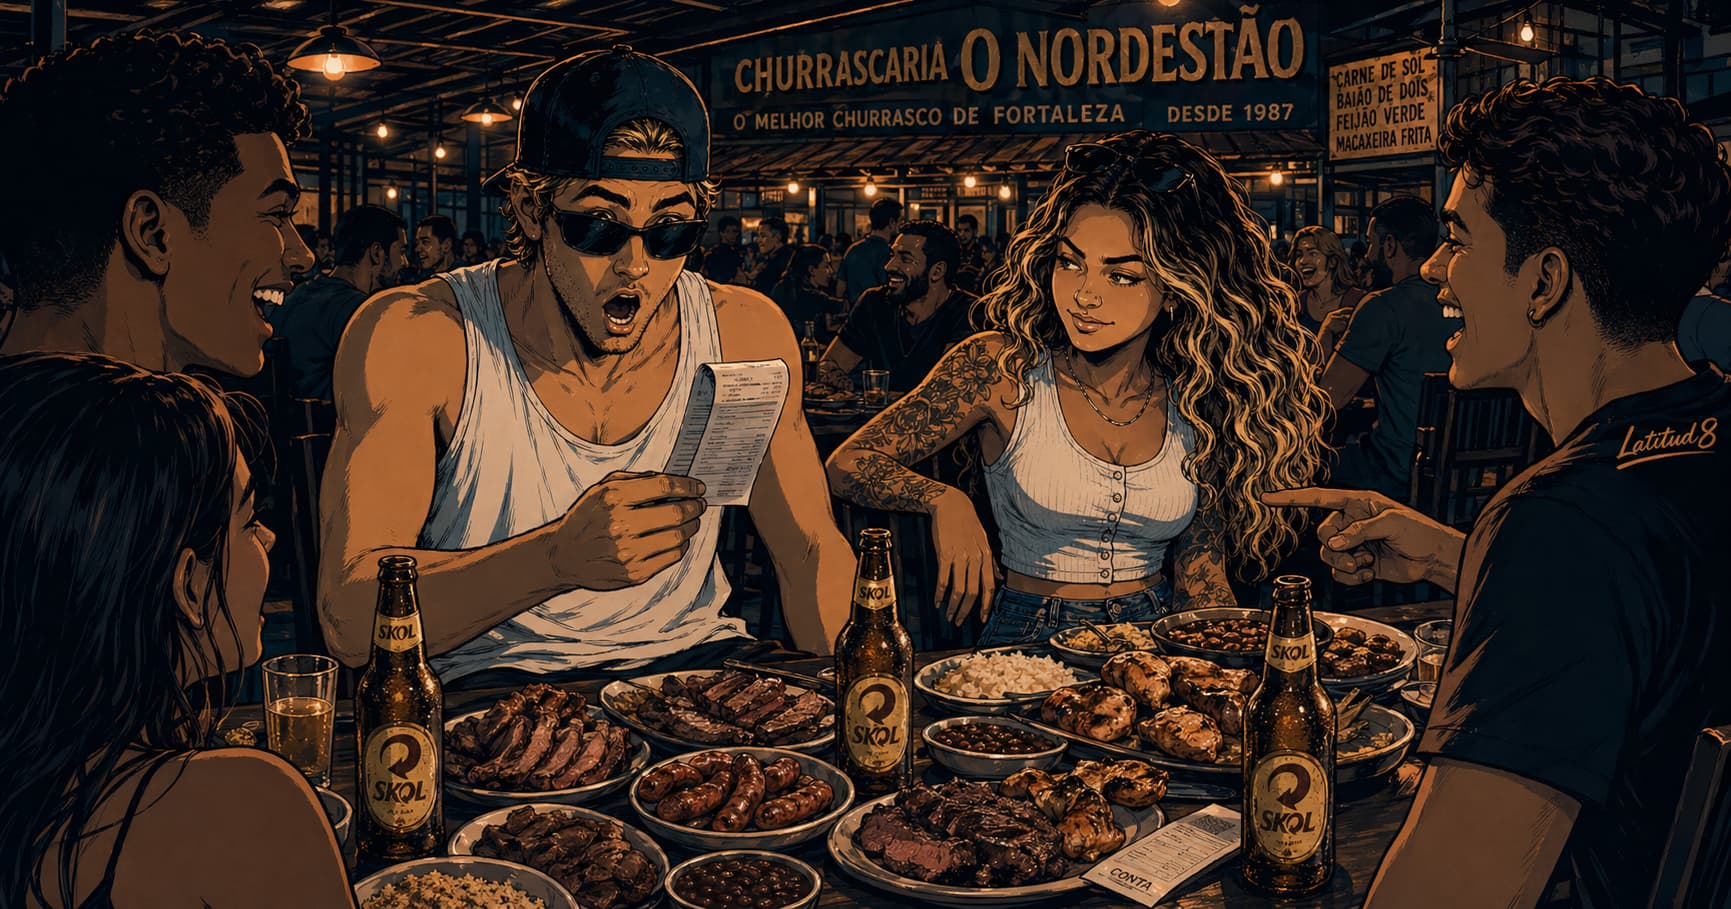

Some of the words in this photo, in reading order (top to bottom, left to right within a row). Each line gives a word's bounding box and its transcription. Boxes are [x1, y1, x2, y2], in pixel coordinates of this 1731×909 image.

[735, 41, 949, 93] CHURRASCARIA
[961, 28, 1000, 91] O
[1016, 5, 1304, 88] NORDESTÃO
[1336, 66, 1375, 88] CARNE
[1381, 61, 1396, 80] DE
[1402, 56, 1425, 76] SOL
[1337, 86, 1372, 110] BAIÃO
[1378, 84, 1393, 103] DE
[1400, 79, 1428, 100] DOIS
[733, 113, 746, 130] O
[755, 112, 824, 129] MELHOR
[832, 107, 943, 128] CHURRASCO
[953, 106, 979, 125] DE
[994, 104, 1125, 124] FORTALEZA
[1167, 104, 1233, 123] DESDE
[1243, 103, 1294, 122] 1987
[1336, 107, 1376, 131] FEIJÃO
[1384, 102, 1425, 125] VERDE
[1336, 130, 1397, 152] MACAXEIRA
[1401, 126, 1432, 146] FRITA
[860, 586, 891, 600] SKOL
[378, 624, 416, 640] SKOL
[1270, 644, 1310, 660] SKOL
[852, 726, 900, 747] SKOL
[373, 781, 426, 804] SKOL
[1260, 810, 1316, 836] SKOL
[1109, 867, 1153, 891] CONTA
